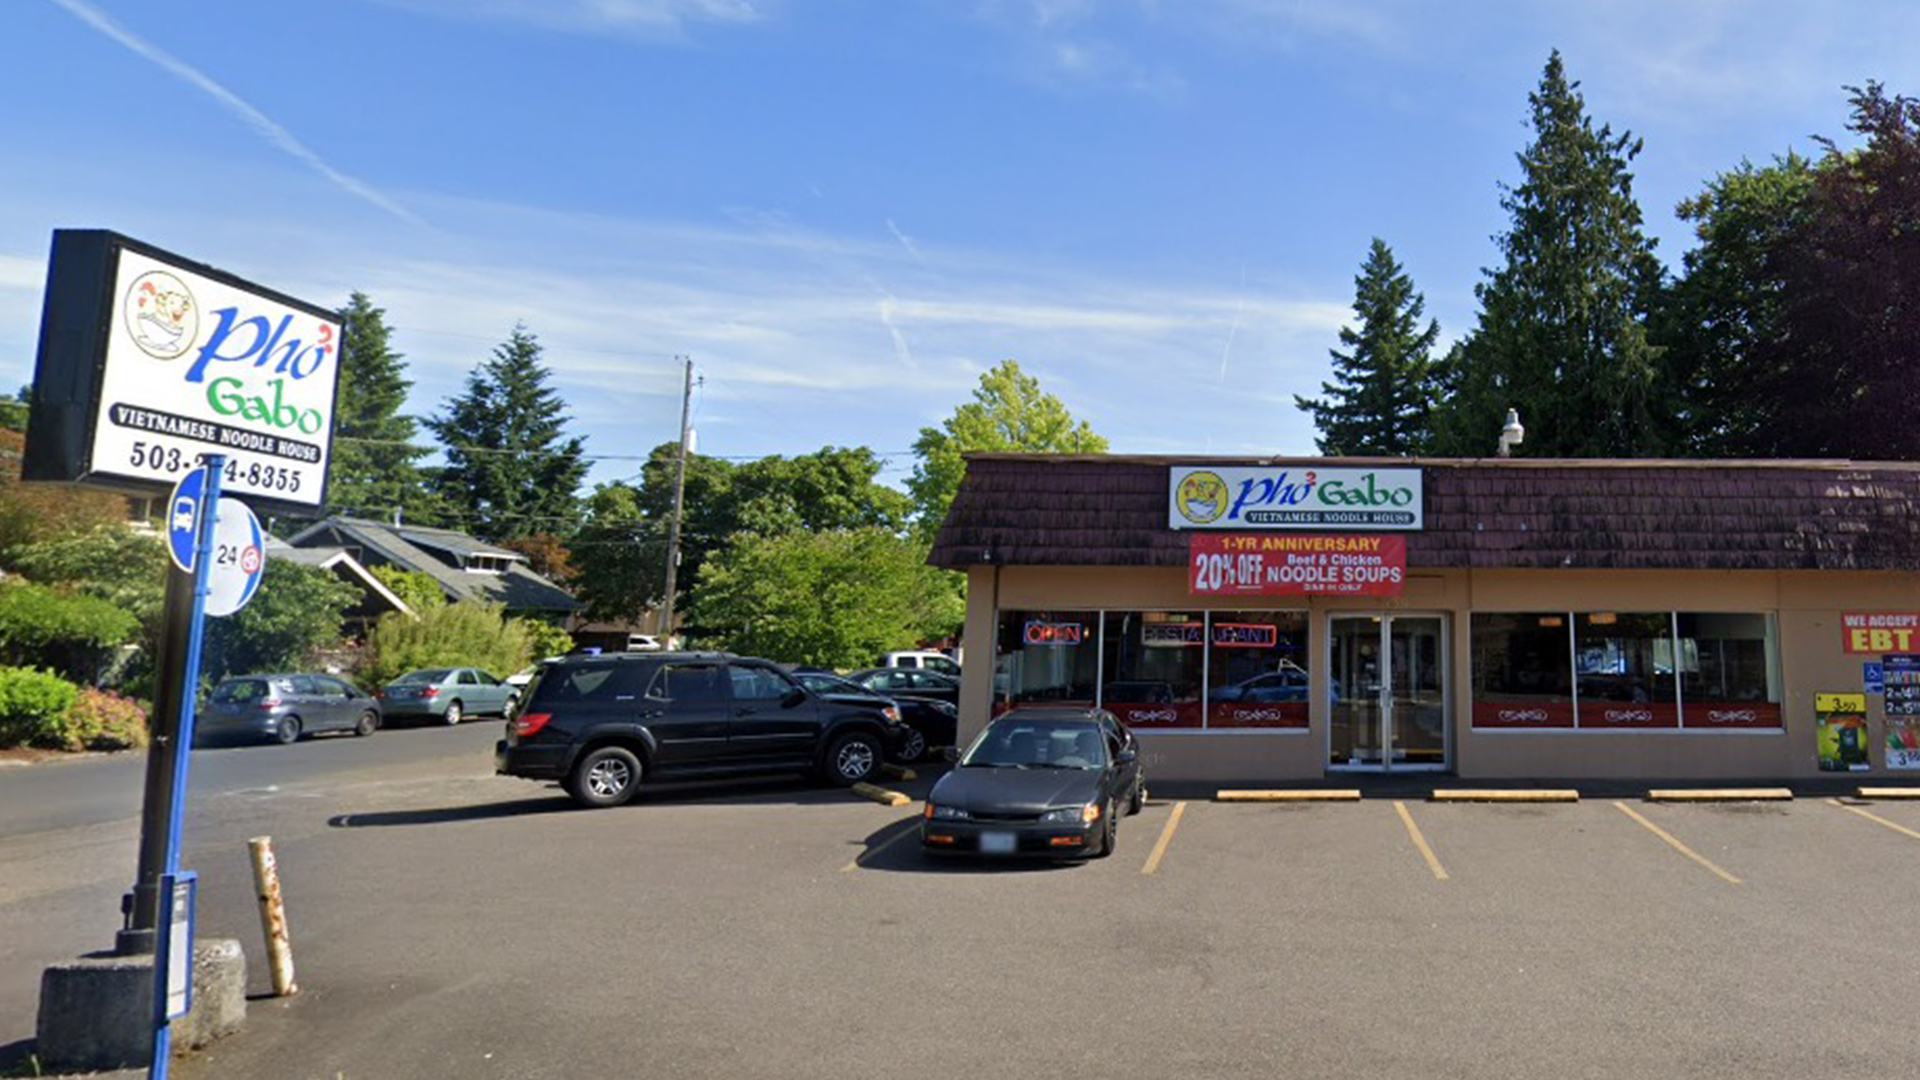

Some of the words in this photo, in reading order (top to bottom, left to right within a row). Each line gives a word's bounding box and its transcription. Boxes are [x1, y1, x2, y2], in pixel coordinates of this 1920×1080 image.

[206, 376, 323, 435] Gabo
[117, 406, 216, 441] VIETNAMESE
[220, 428, 274, 452] NOODLE
[278, 440, 318, 461] HOUSE
[130, 441, 301, 493] 503-24-8355
[1317, 472, 1413, 506] Gabo
[1250, 512, 1320, 523] VIETNAMESE
[1323, 512, 1369, 523] NOODLE
[1373, 512, 1411, 523] HOUSE
[217, 544, 237, 565] 24
[1221, 537, 1257, 550] 1-YR
[1262, 537, 1381, 551] ANNIVERSARY
[1287, 554, 1316, 566] Beef
[1318, 554, 1327, 566] &
[1331, 554, 1382, 566] Chicken
[1196, 552, 1235, 590] 20%
[1237, 554, 1263, 585] OFF
[1267, 566, 1338, 582] NOODLE
[1342, 566, 1402, 582] SOUPS
[1844, 614, 1866, 627] WE
[1868, 614, 1919, 627] ACCEPT
[1026, 625, 1081, 643] OPEN
[1851, 629, 1914, 651] EBT
